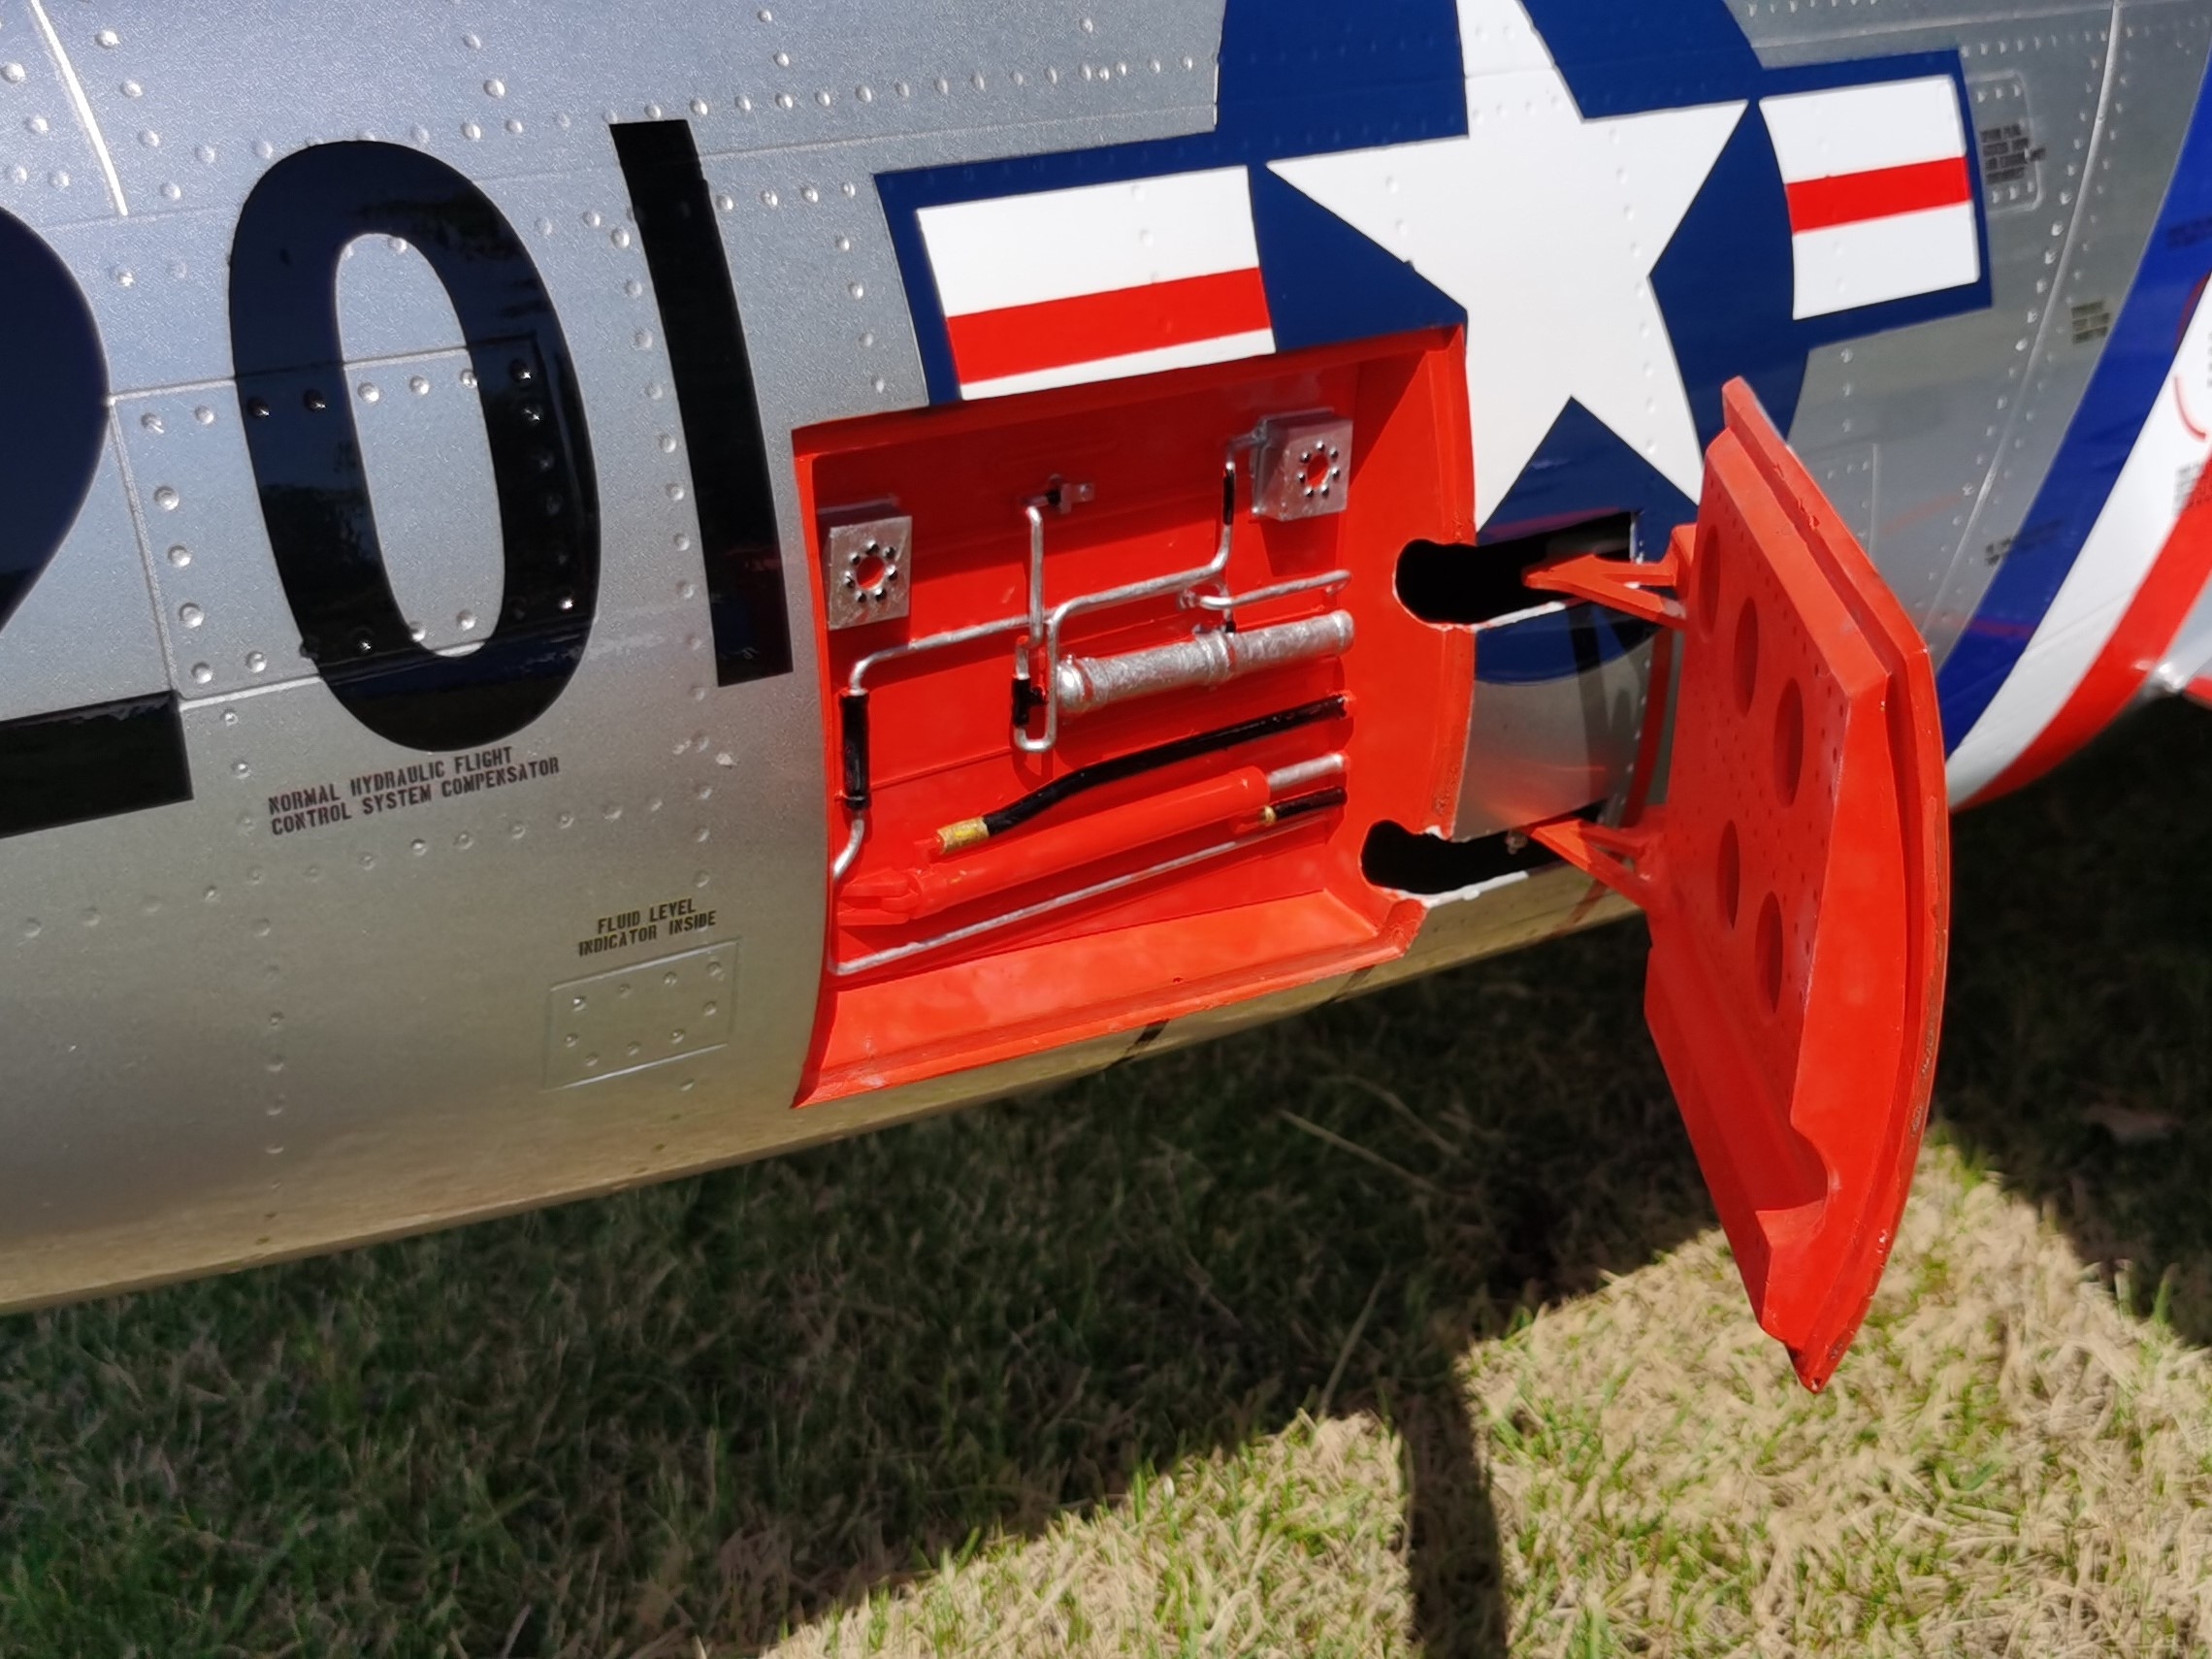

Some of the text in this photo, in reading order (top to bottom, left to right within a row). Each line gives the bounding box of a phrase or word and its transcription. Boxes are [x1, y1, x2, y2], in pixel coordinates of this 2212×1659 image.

[268, 746, 512, 815] NORMAL HYDRAULIC FLIGHT
[272, 757, 560, 835] CONTROL SYSTEM COMPENSATOR
[578, 910, 717, 957] INDICATOR INSIDE
[598, 898, 697, 934] FLUID LEVEL
